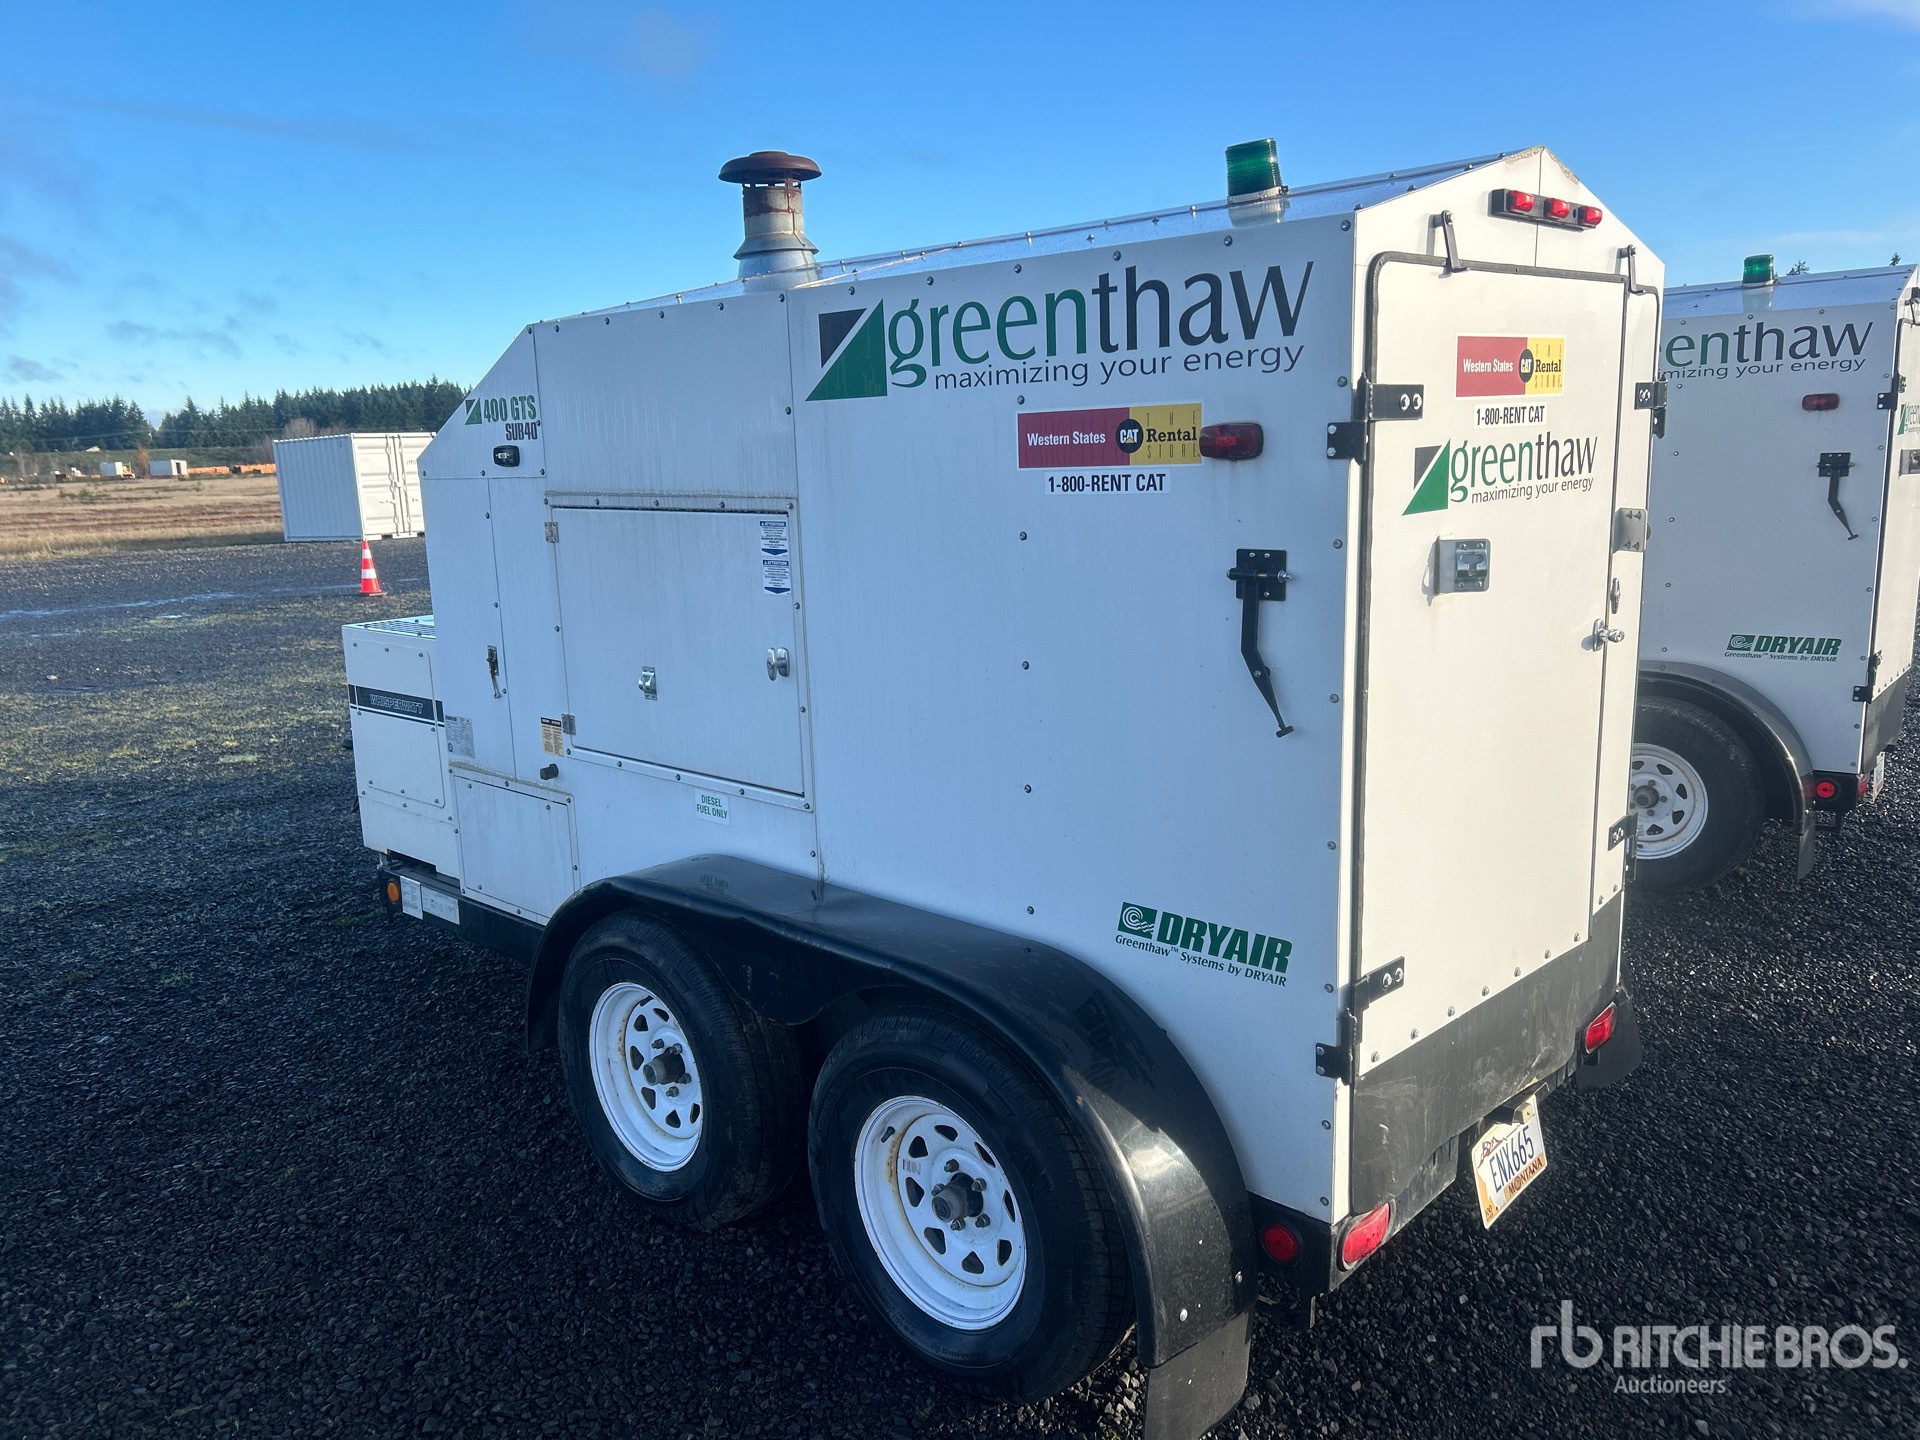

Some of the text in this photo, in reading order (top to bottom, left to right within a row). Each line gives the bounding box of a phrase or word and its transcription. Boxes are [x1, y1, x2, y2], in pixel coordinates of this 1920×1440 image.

[888, 261, 1314, 388] greenthaw
[1659, 321, 1874, 368] enthaw
[935, 344, 1305, 390] maximizing your energy
[1463, 358, 1562, 373] Western States CAT Rental
[1735, 363, 1784, 378] your
[1790, 358, 1866, 372] energy
[483, 394, 537, 422] 400 GTS
[1146, 410, 1198, 426] THE
[1476, 405, 1545, 426] 1-800-RENT CAT
[505, 421, 538, 441] SUB40
[1027, 427, 1197, 446] Western States CAT Rental
[1450, 431, 1598, 503] greenthaw
[1048, 473, 1166, 493] 1-800-RENT CAT
[1472, 476, 1594, 504] maximizing your energy
[1753, 635, 1842, 655] DRYAIR
[1769, 653, 1798, 661] Systems
[696, 803, 728, 819] FUEL ONLY
[701, 794, 722, 808] DIESEL
[1156, 911, 1292, 974] DRYAIR
[1180, 951, 1224, 971] Systems
[1227, 962, 1242, 977] by
[1244, 968, 1287, 987] DRYAIR
[1489, 1125, 1535, 1193] ENX665
[1508, 1157, 1543, 1197] MONTANA
